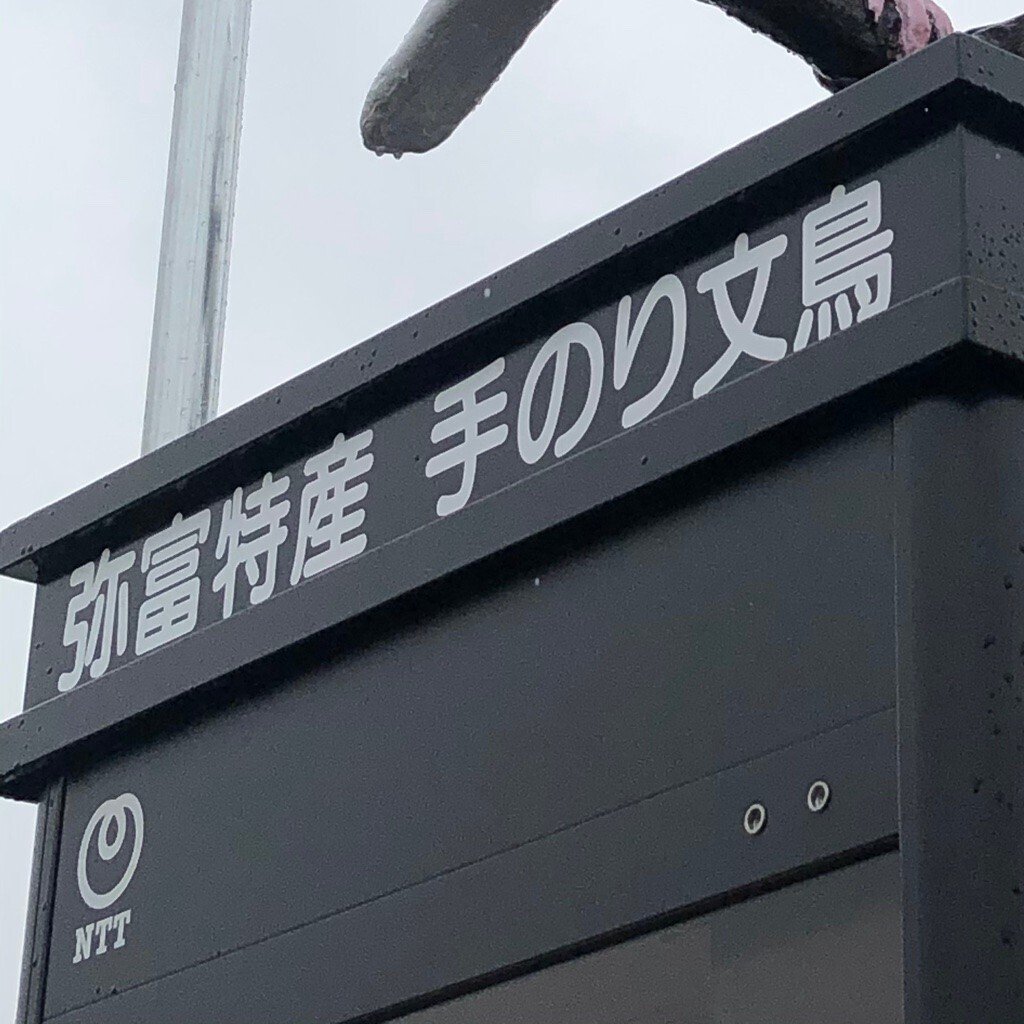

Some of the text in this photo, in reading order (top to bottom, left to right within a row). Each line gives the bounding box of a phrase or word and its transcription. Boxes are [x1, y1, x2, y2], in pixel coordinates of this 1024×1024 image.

[57, 181, 893, 692] 弥富特産 手のり文鳥
[73, 910, 131, 963] NTT
